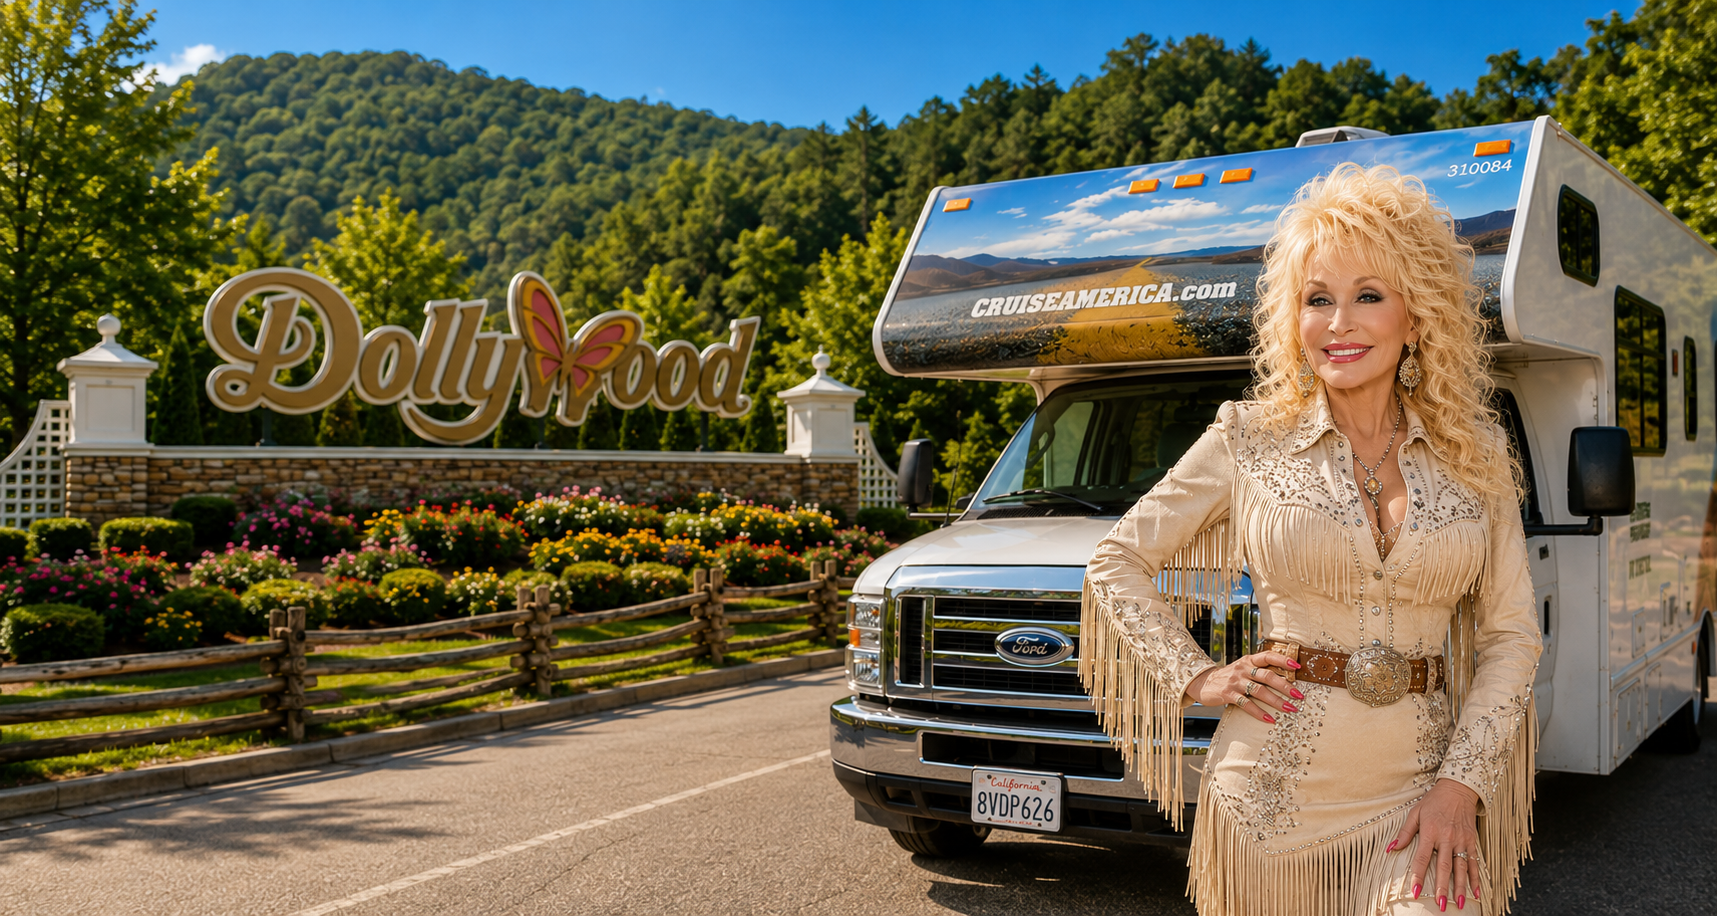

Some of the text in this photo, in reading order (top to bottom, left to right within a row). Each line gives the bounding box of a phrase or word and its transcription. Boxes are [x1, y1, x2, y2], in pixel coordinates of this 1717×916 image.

[1447, 159, 1512, 177] 310084
[970, 281, 1238, 318] CRUISEAMERICA.com
[1012, 636, 1048, 655] Ford
[990, 777, 1042, 792] California
[977, 791, 1054, 822] 8VDP626
